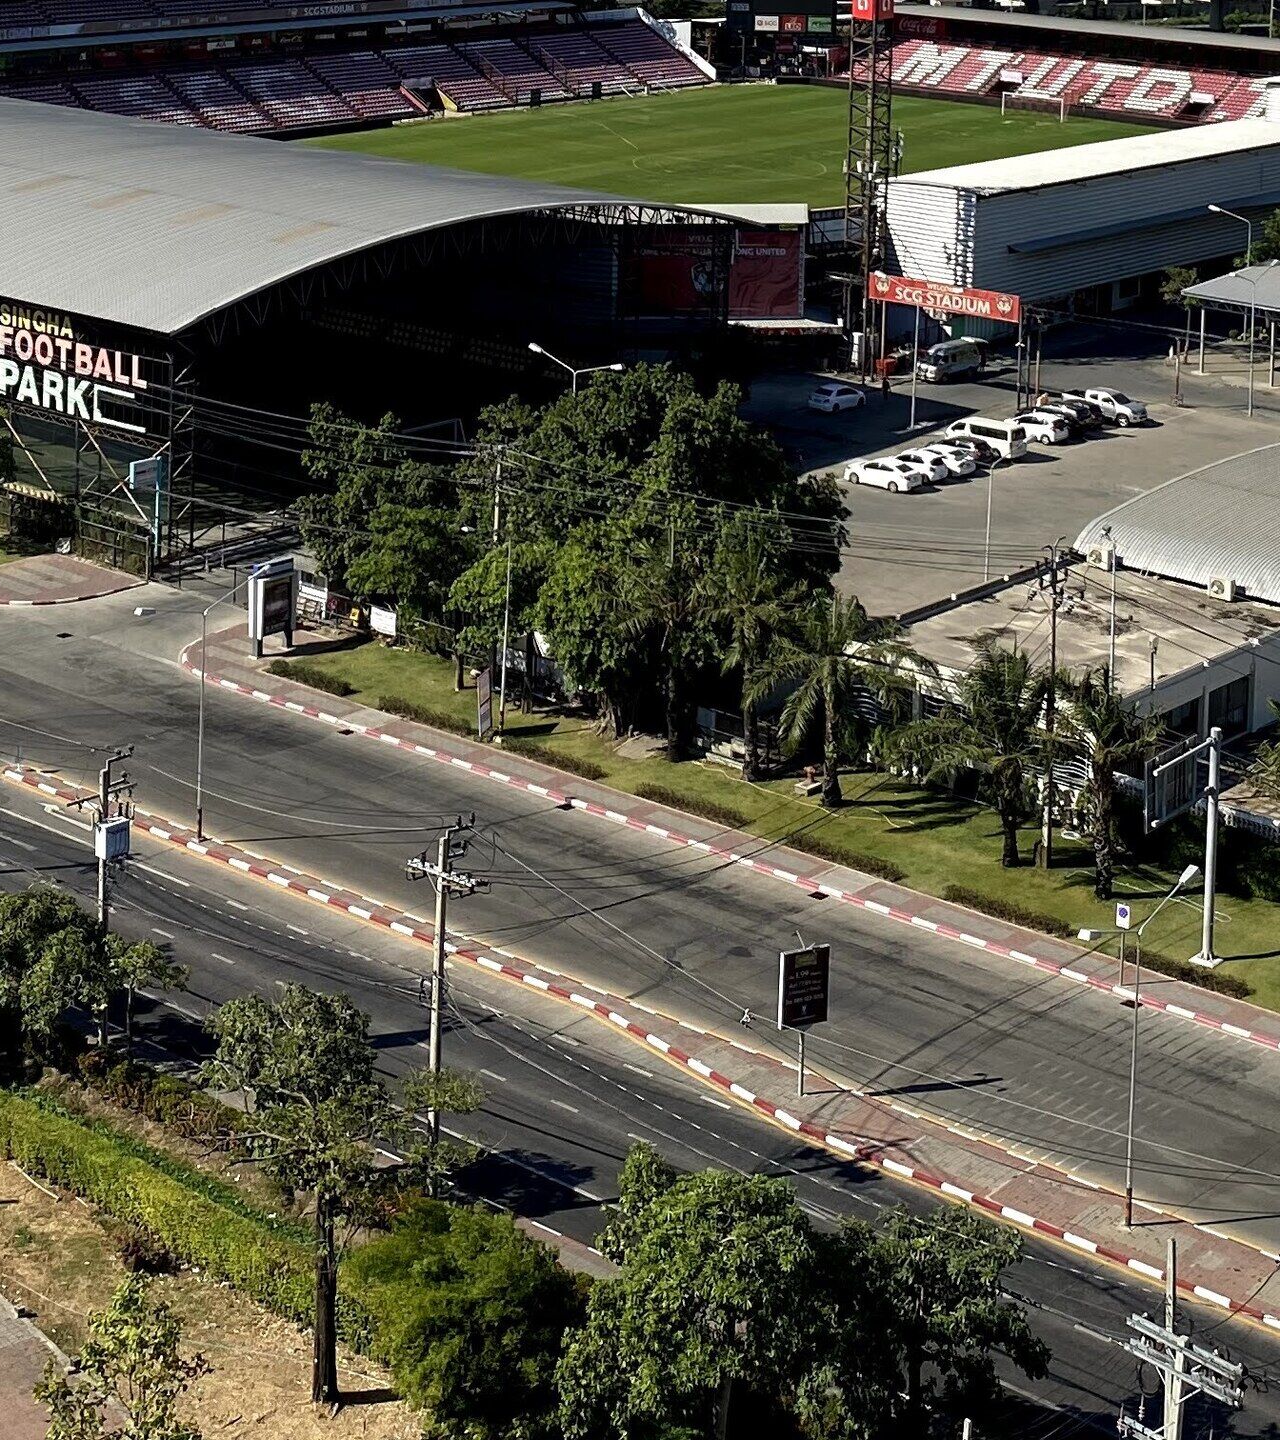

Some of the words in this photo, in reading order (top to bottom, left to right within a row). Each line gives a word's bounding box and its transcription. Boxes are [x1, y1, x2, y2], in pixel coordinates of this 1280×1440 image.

[755, 247, 786, 256] UNITED
[894, 286, 923, 303] SCG
[926, 292, 991, 315] STADIUM
[0, 304, 74, 339] SINGHA
